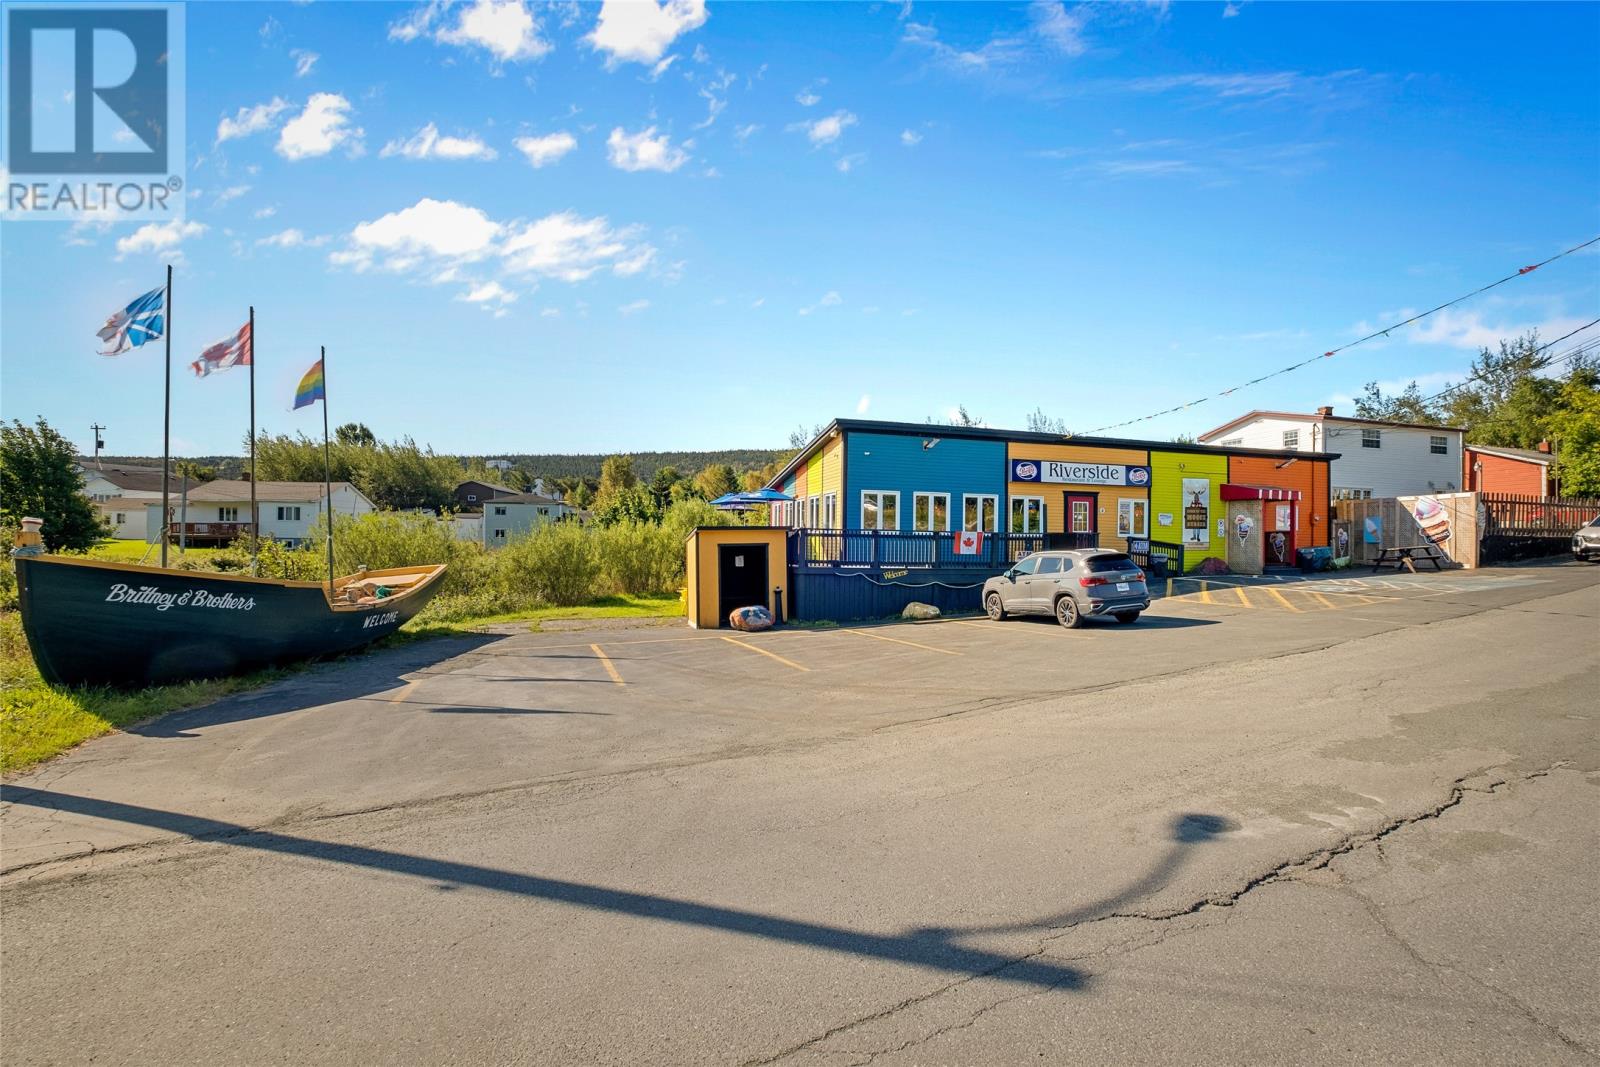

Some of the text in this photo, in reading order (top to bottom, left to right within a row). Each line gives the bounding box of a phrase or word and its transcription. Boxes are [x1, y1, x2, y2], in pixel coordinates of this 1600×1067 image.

[1049, 462, 1119, 481] Riverside
[883, 570, 909, 580] Welcome
[105, 583, 256, 611] Brittney & Brothers
[363, 610, 399, 629] WELCOME
